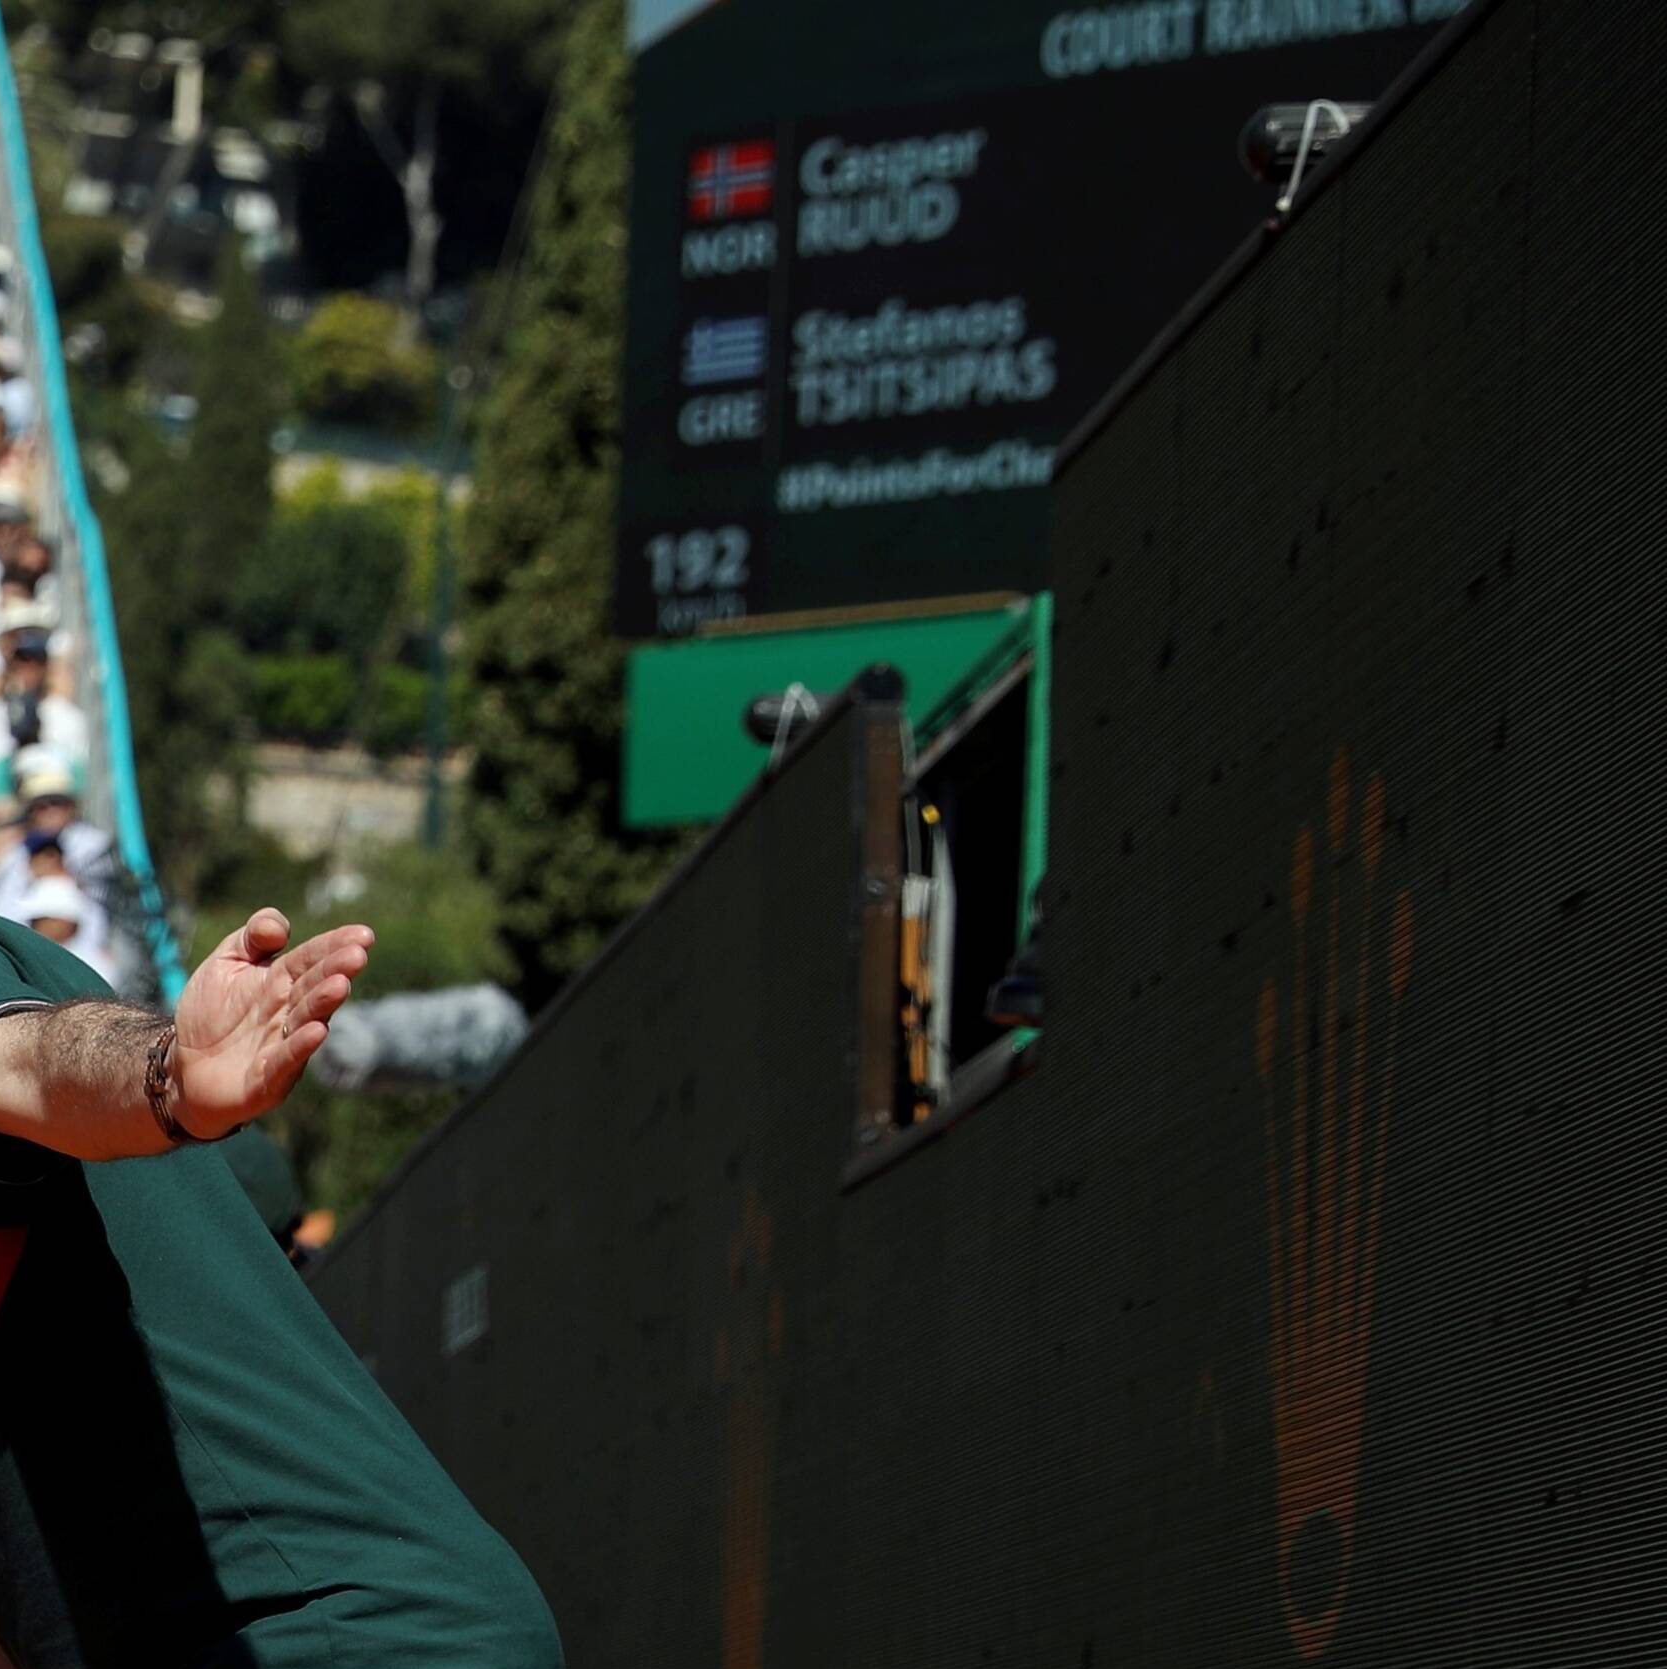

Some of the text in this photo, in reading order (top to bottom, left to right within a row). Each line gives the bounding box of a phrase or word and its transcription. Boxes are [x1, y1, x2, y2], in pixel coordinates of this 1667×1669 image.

[1041, 0, 1194, 79] COURT
[799, 128, 987, 196] Casper
[682, 221, 777, 278] NOR
[796, 182, 959, 257] RUUD
[793, 297, 1024, 365] Stefanos
[788, 338, 1055, 426] TSITSIPAS
[678, 390, 765, 446] GRE
[644, 526, 750, 594] 192
